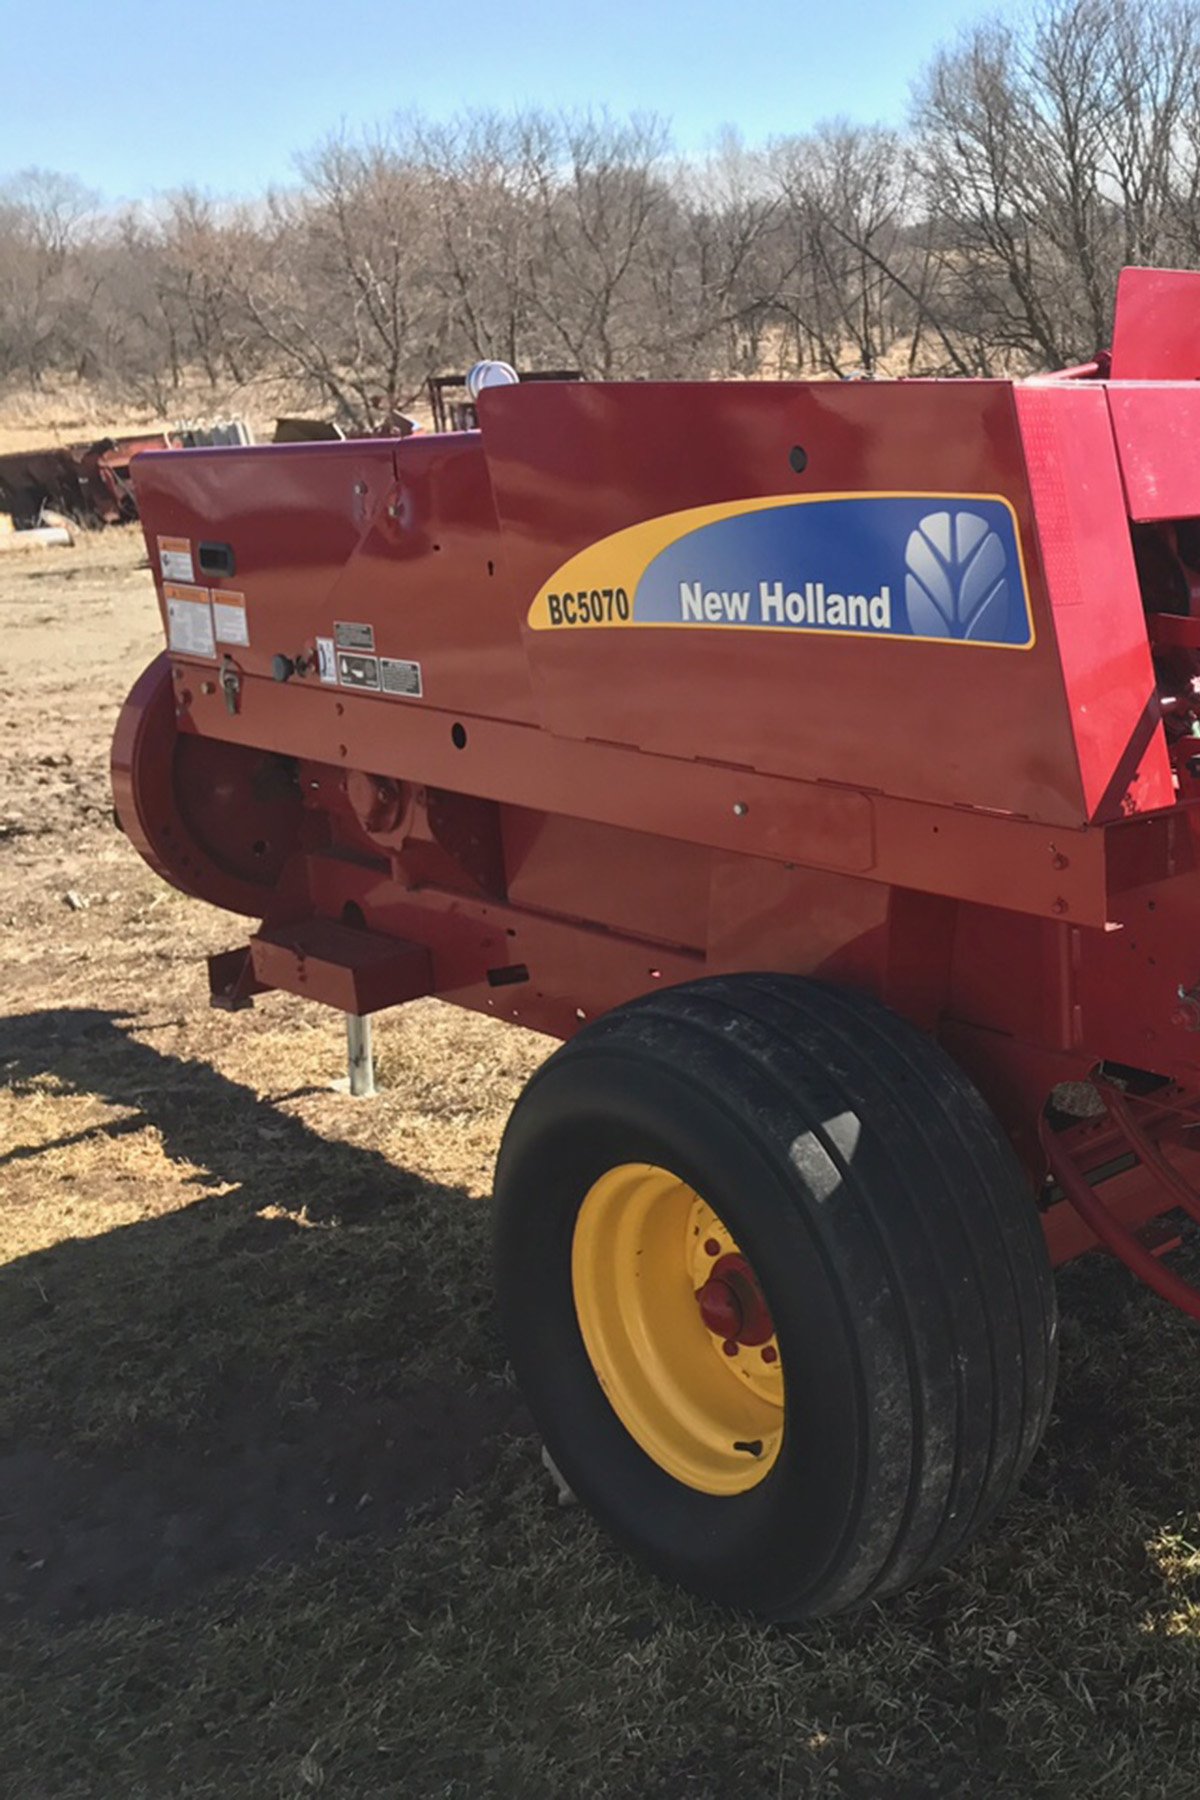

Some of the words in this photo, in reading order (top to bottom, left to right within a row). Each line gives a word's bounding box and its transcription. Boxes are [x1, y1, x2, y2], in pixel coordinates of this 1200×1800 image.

[546, 587, 630, 626] BC5070
[679, 581, 750, 622] New
[759, 581, 892, 629] Holland
